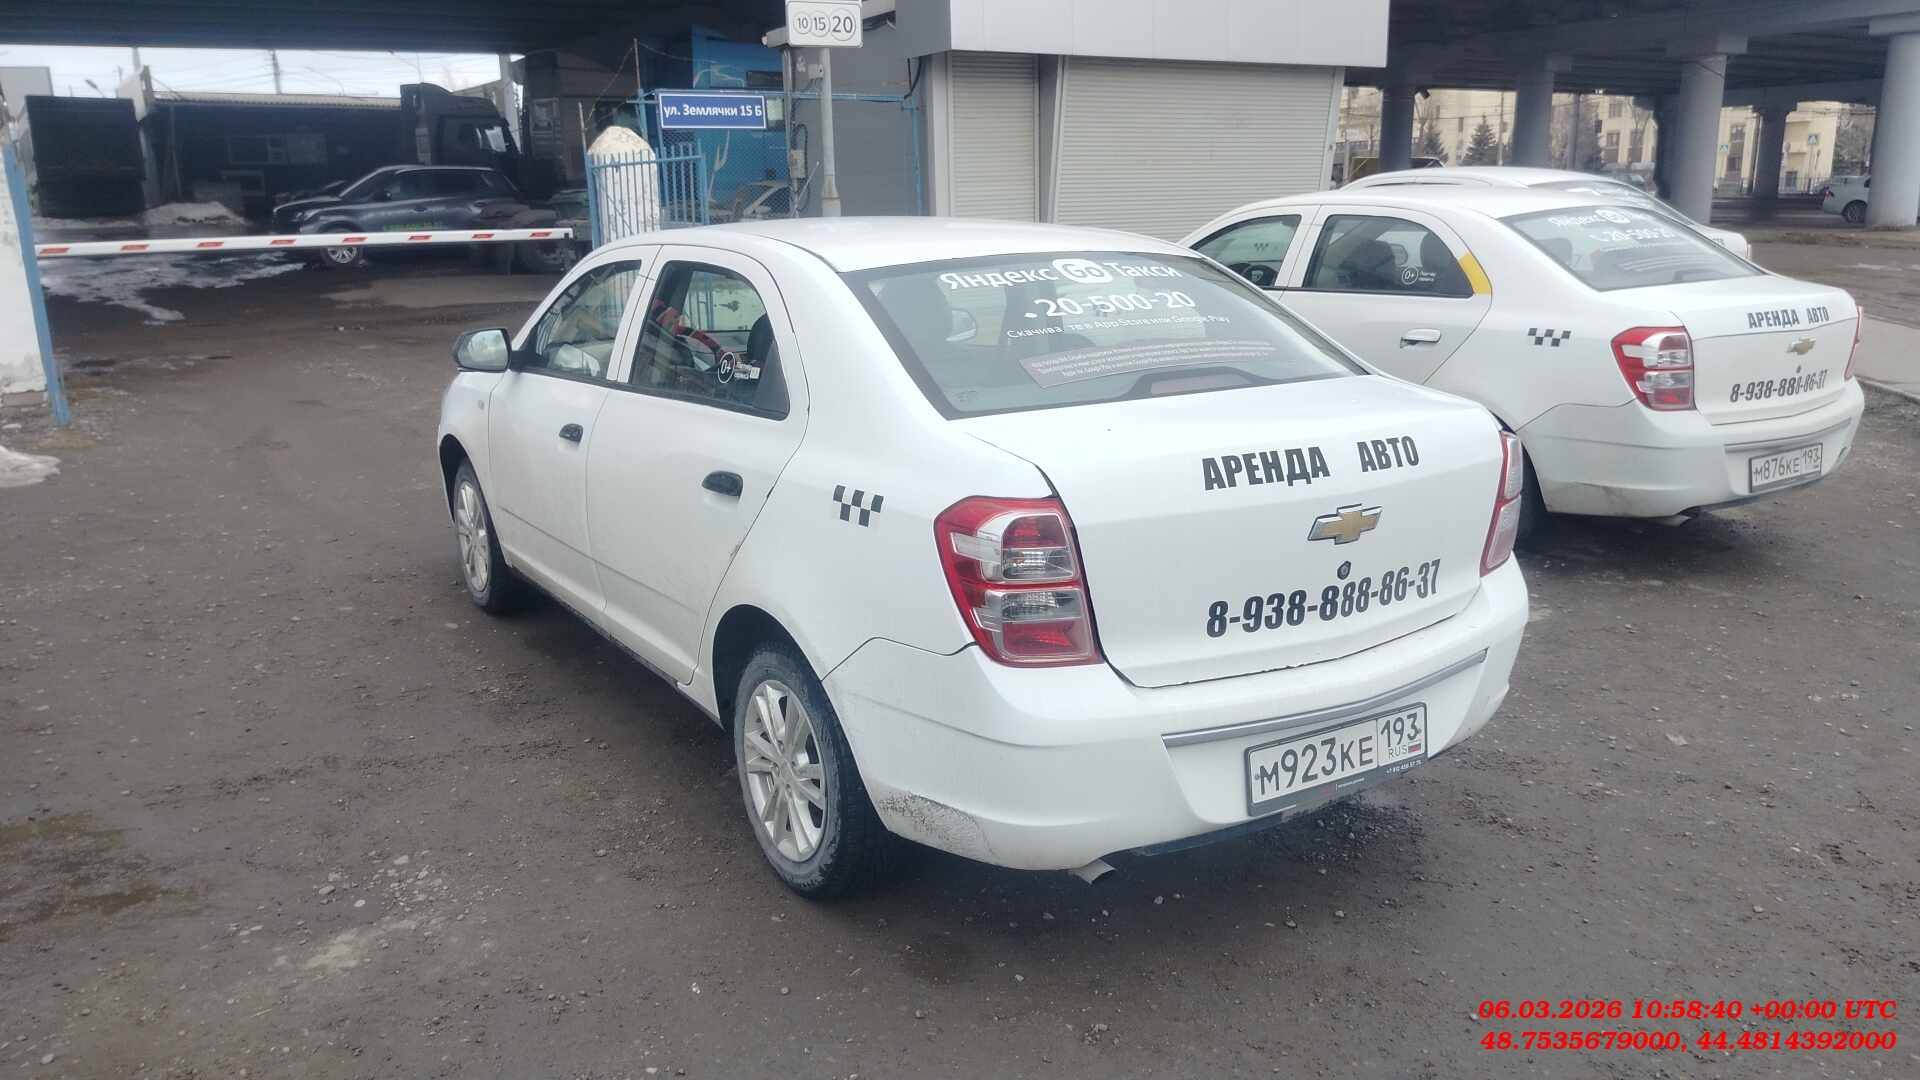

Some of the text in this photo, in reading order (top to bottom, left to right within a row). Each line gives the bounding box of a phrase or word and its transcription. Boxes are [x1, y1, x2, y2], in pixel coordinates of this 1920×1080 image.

[797, 15, 853, 33] 10 15 20
[663, 104, 762, 118] ул. Землячки 15 Б
[939, 268, 1059, 290] Яндекс
[1103, 262, 1182, 279] Такси
[1747, 306, 1830, 328] АРЕНДА АВТО
[720, 359, 731, 374] 0+
[1202, 435, 1420, 491] АРЕНДА АВТО
[1206, 558, 1441, 638] 8-938-888-86-37
[1258, 712, 1418, 795] М923КЕ 193
[1387, 744, 1407, 760] RUS
